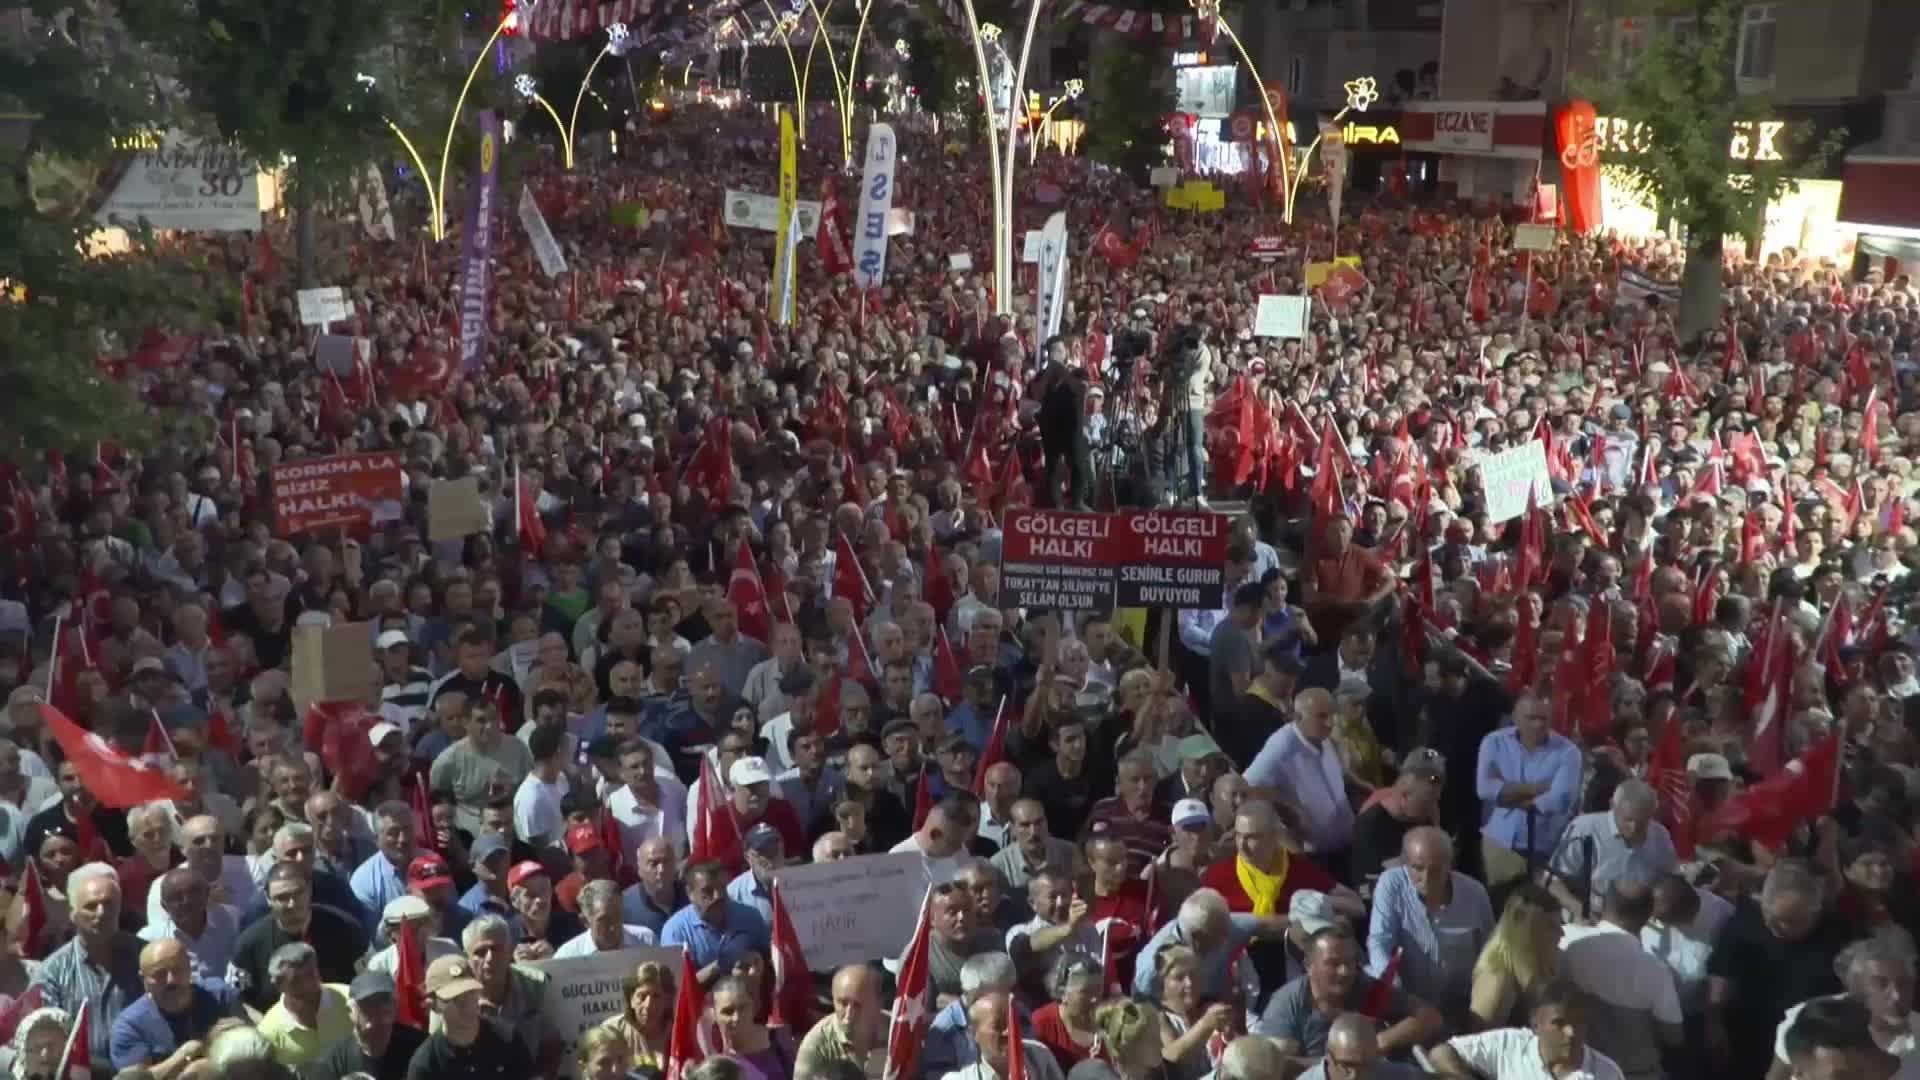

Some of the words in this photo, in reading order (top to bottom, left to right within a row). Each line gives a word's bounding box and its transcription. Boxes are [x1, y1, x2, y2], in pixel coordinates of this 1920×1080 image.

[1437, 111, 1488, 133] ECZANE
[274, 460, 362, 480] KORKMA
[368, 456, 396, 470] LA
[1015, 512, 1110, 537] GÖLGELİ
[1130, 511, 1217, 537] GÖLGELİ
[1029, 537, 1093, 559] HALKI
[1144, 537, 1202, 556] HALKI
[1121, 564, 1173, 583] SENİNLE
[1177, 568, 1220, 585] GURUR
[1019, 591, 1056, 606] SELAM
[1058, 593, 1093, 608] OLSUN
[1140, 586, 1200, 604] DUYUYOR
